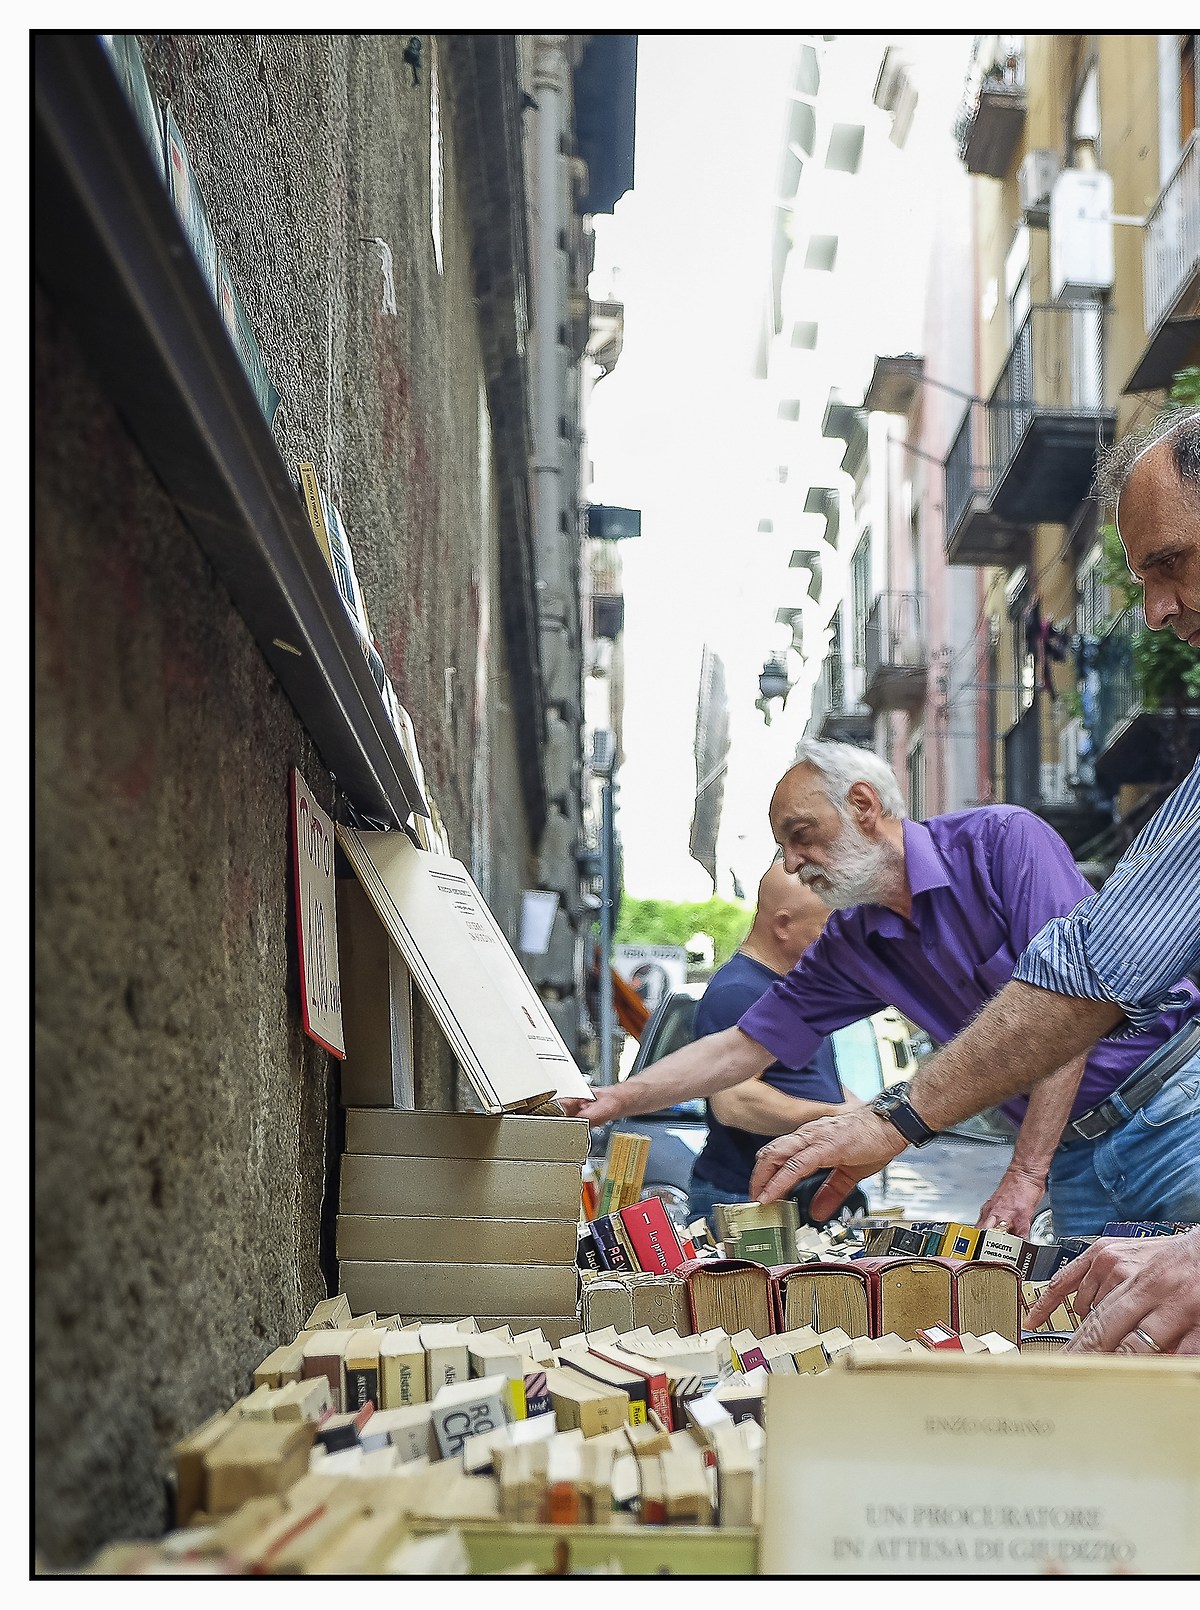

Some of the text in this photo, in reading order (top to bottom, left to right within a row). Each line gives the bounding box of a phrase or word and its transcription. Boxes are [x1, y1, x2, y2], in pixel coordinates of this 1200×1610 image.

[642, 1213, 651, 1226] 1
[648, 1229, 660, 1242] Le
[650, 1242, 669, 1268] prime
[865, 1503, 1104, 1530] UN PROCURATORE
[831, 1536, 1138, 1563] IN ATTESA DI GIUDIZIO
